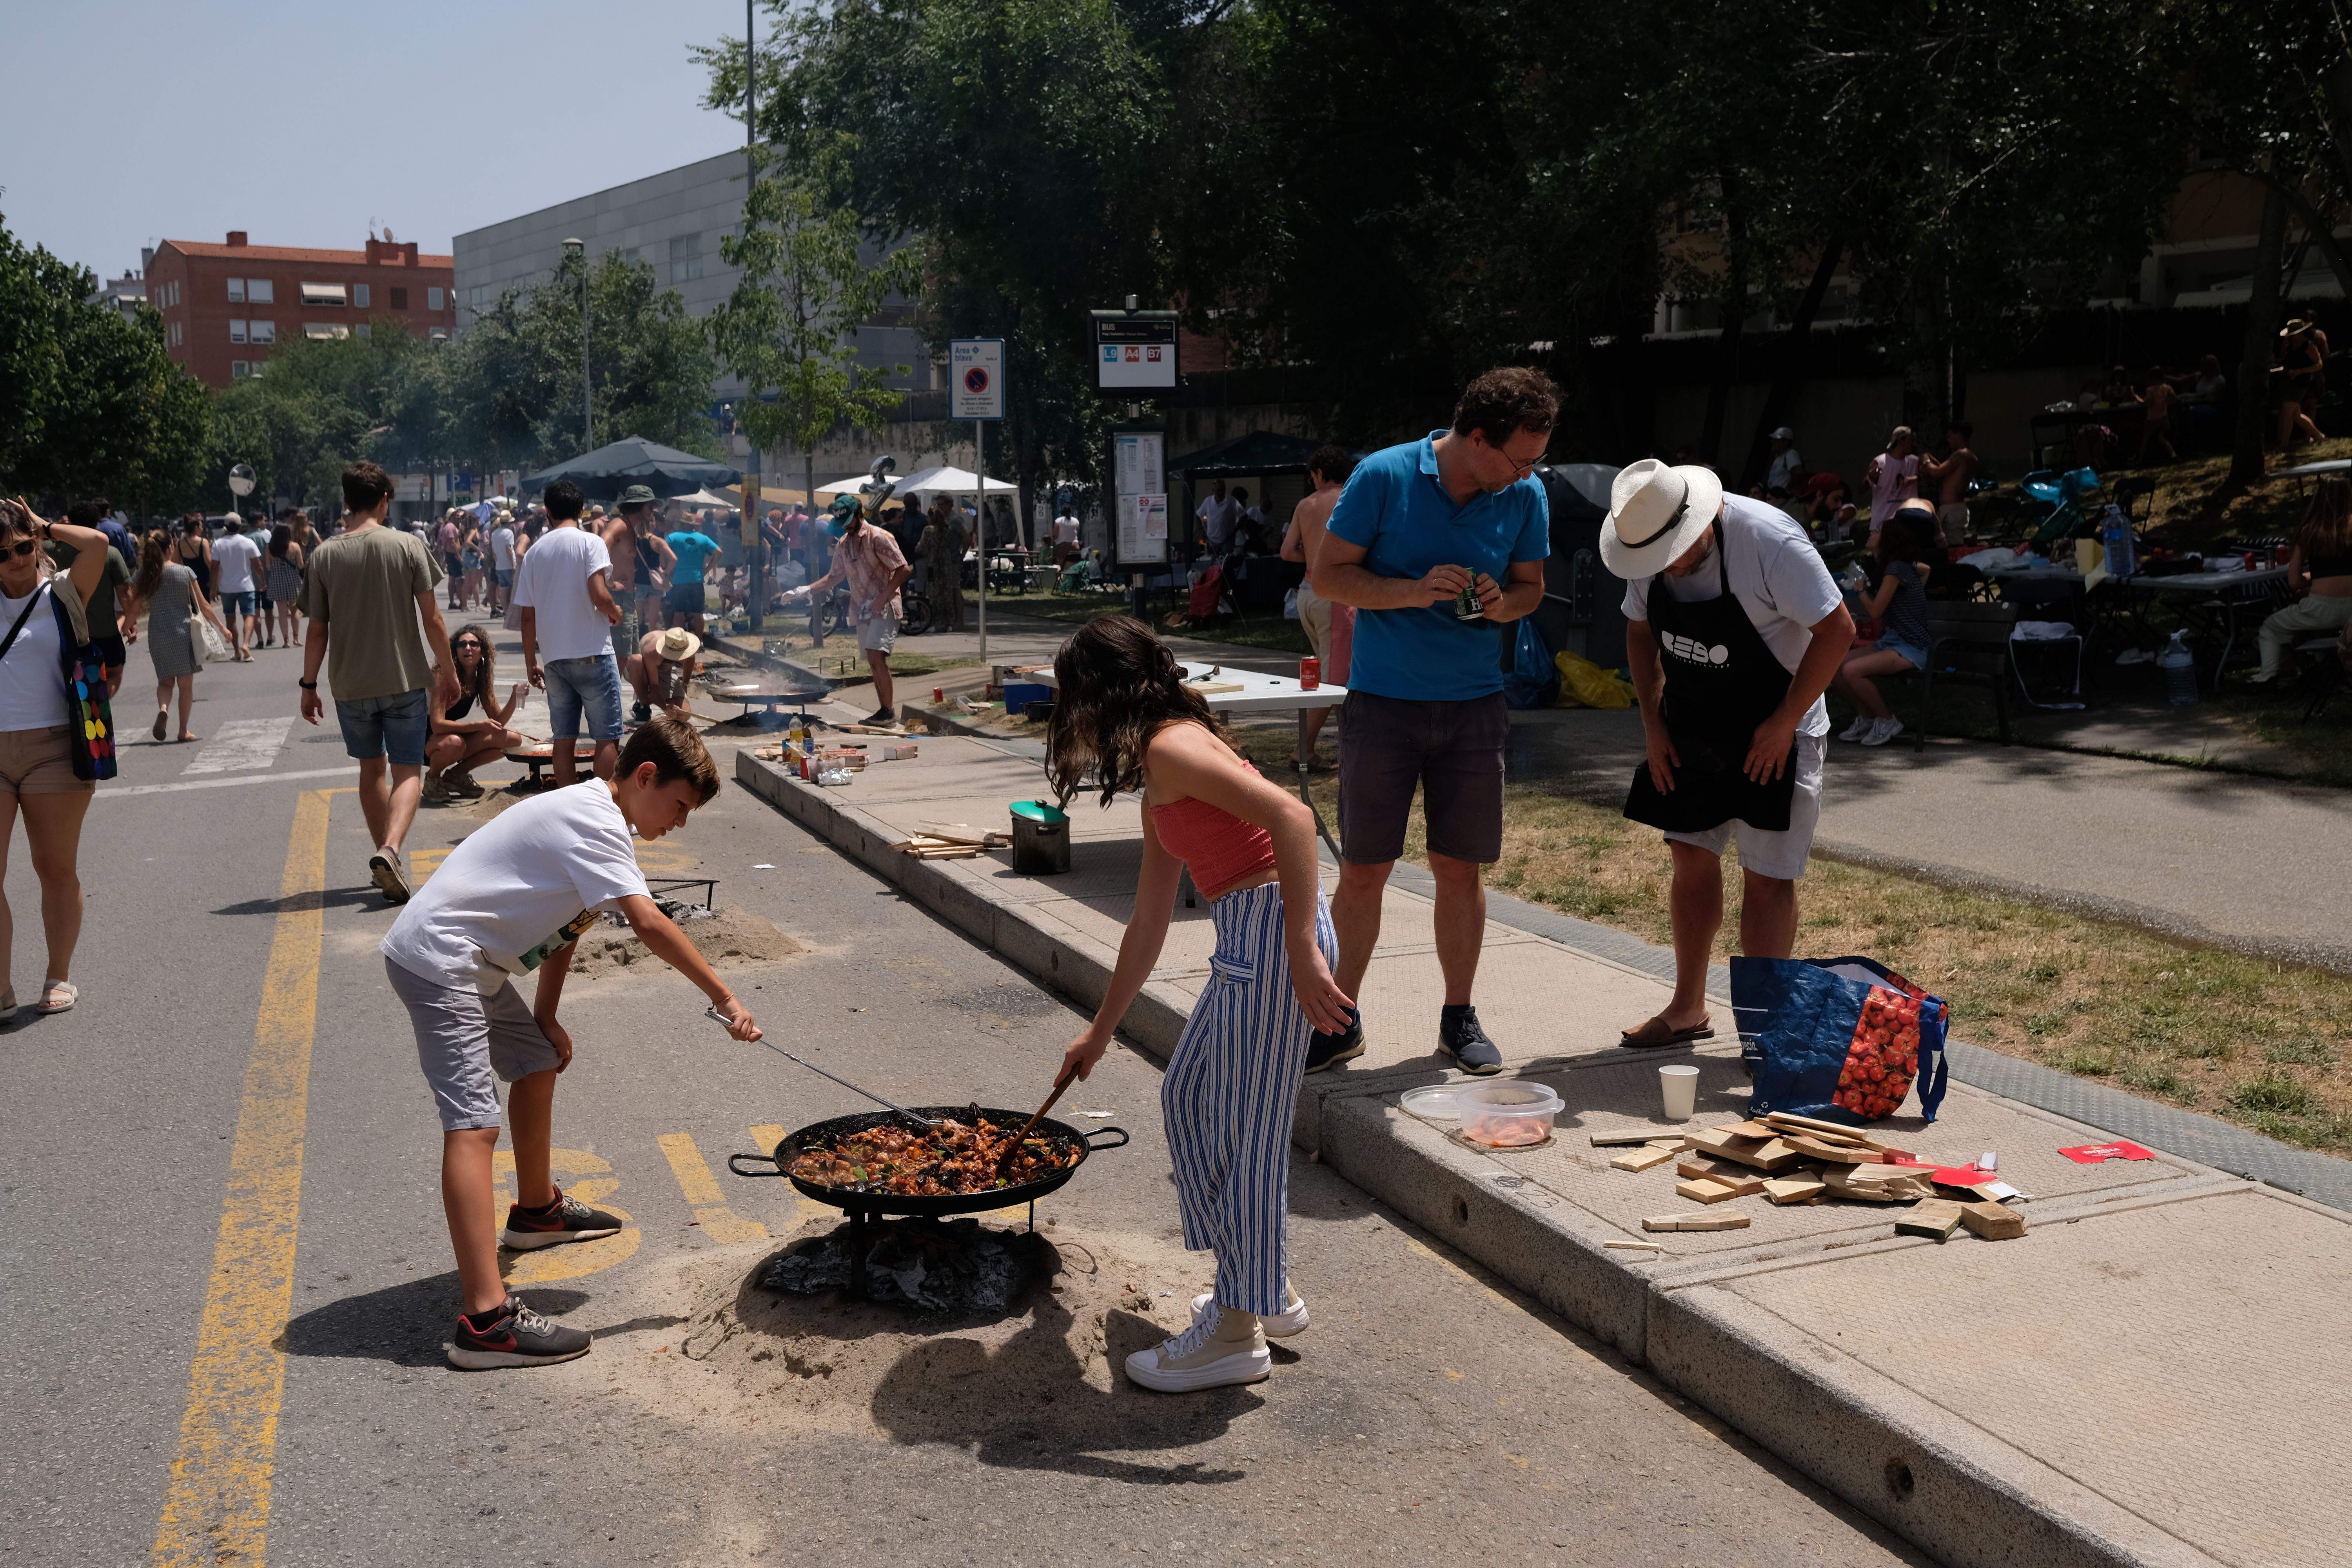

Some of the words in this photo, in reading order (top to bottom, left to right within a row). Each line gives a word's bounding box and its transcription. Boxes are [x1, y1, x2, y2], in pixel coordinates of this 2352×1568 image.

[955, 345, 970, 354] Àrea
[1104, 349, 1117, 358] L9
[1126, 349, 1139, 358] A4
[1147, 349, 1161, 358] B7
